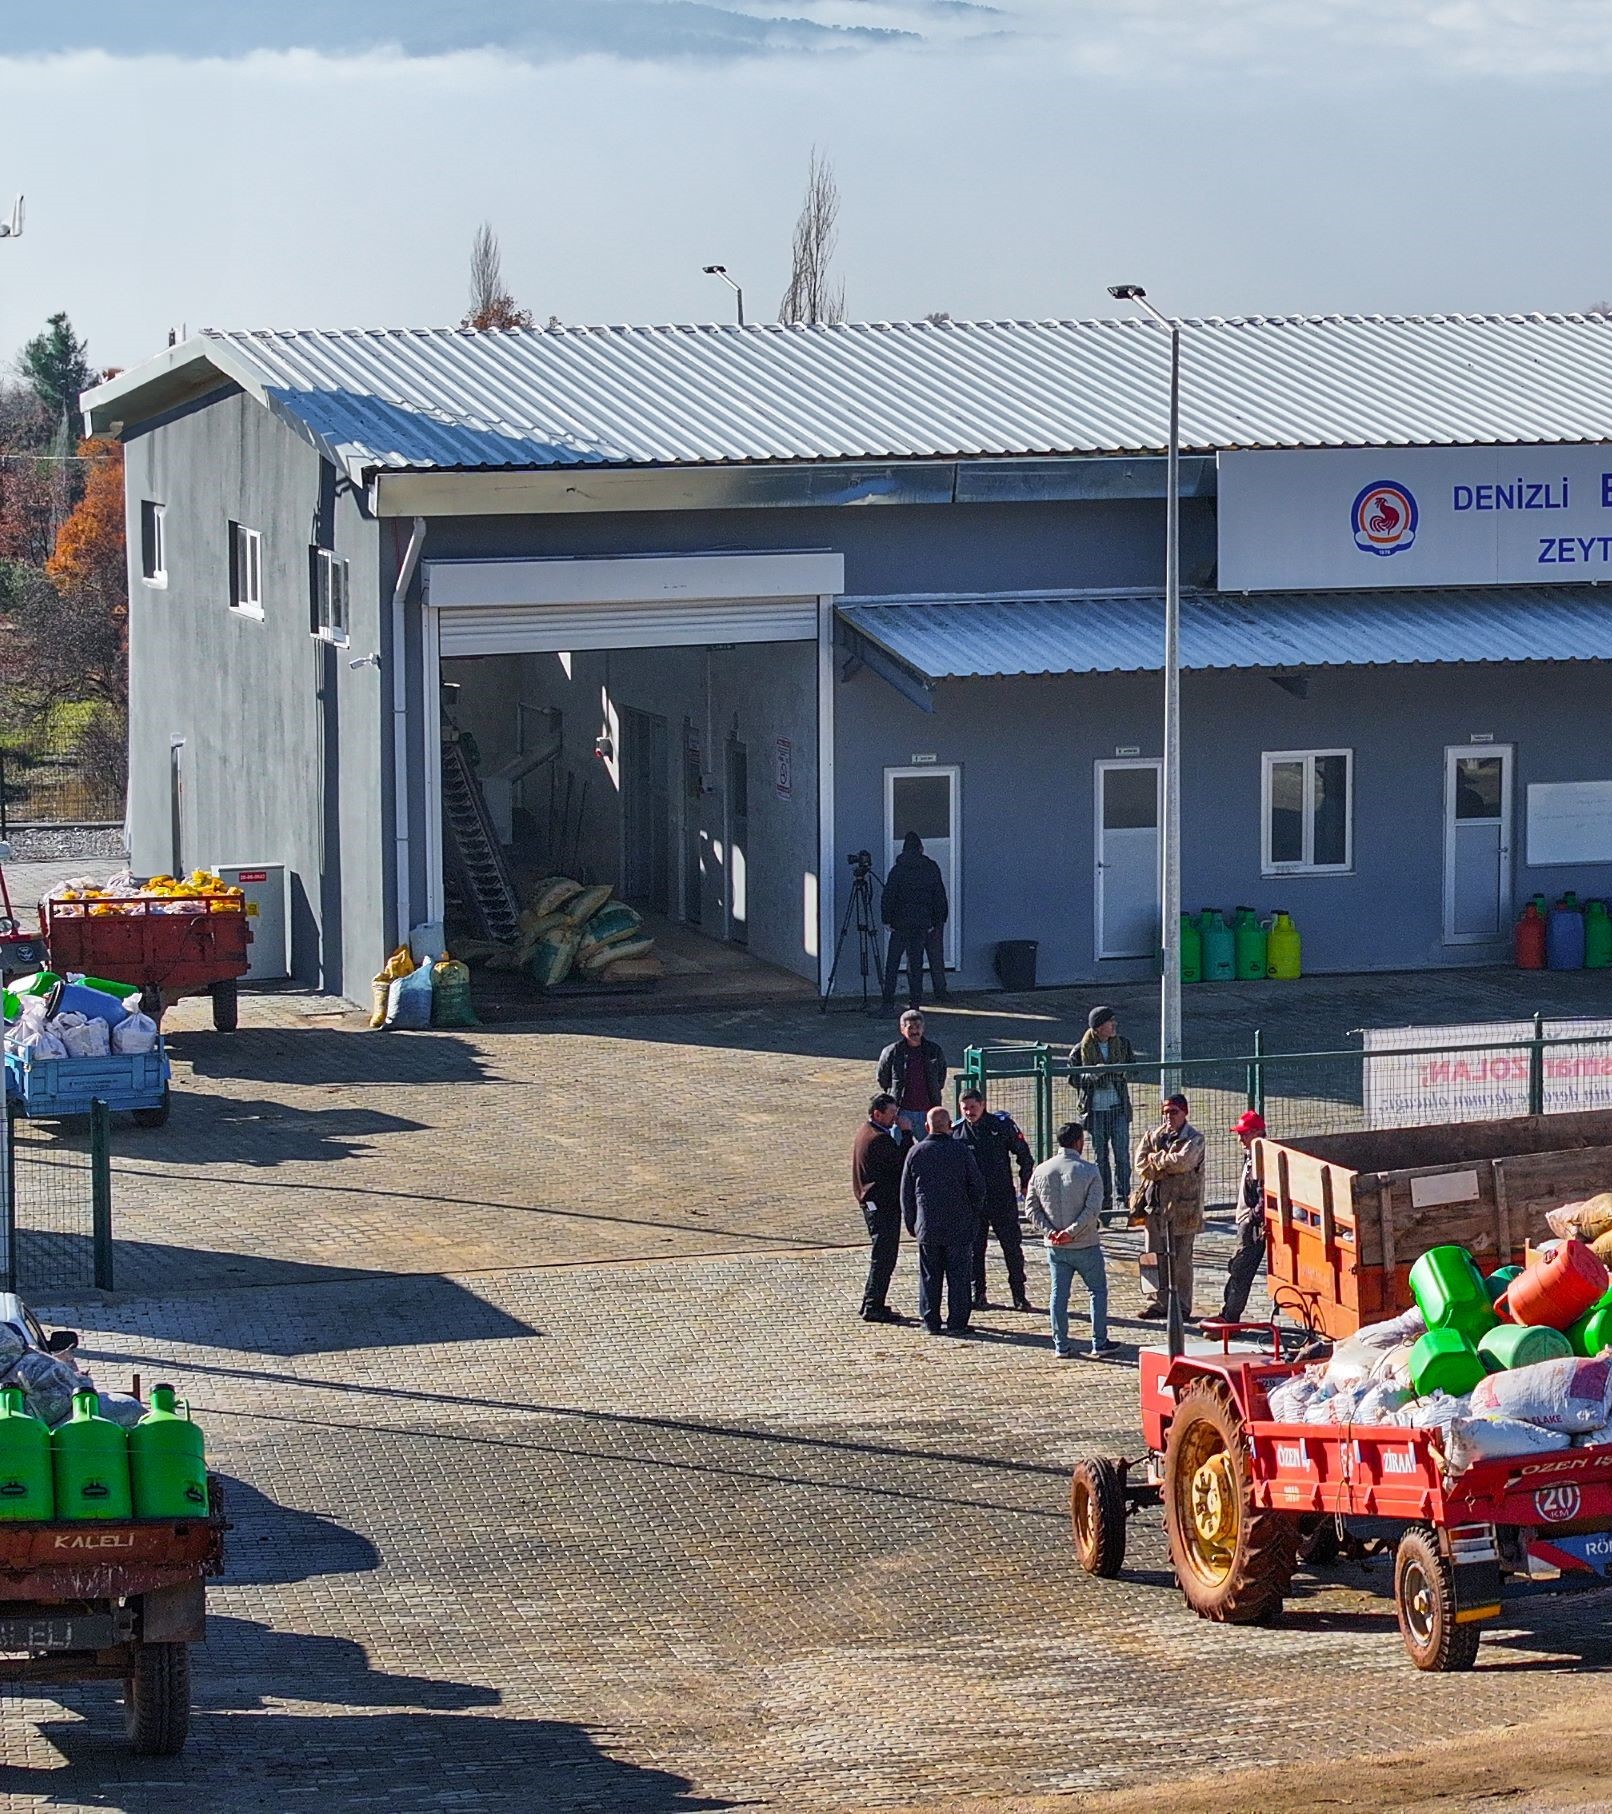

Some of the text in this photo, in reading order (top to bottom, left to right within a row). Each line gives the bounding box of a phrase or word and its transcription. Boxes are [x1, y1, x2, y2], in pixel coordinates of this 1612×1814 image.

[1453, 477, 1569, 511] DENİZLİ
[1543, 1487, 1573, 1511] 20
[1551, 1509, 1570, 1519] KM
